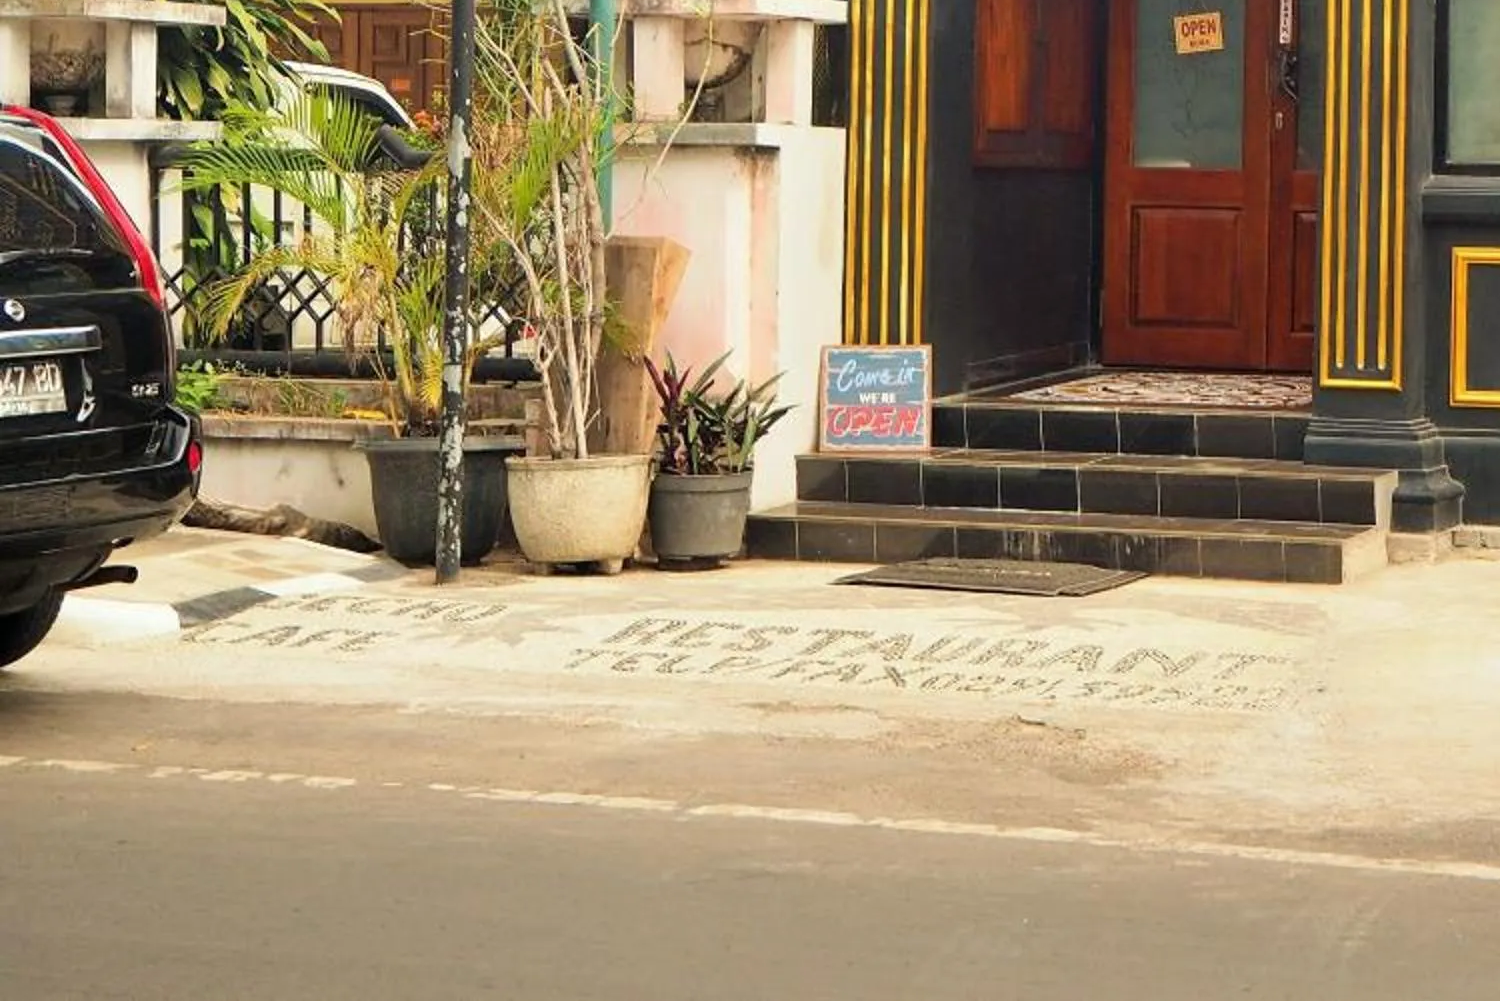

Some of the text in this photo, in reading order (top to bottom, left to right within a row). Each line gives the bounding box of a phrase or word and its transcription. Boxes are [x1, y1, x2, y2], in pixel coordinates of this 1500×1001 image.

[1181, 18, 1217, 38] OPEN
[836, 359, 892, 392] Come
[829, 406, 920, 437] OPEN
[180, 622, 398, 652] CAFE
[603, 617, 1290, 680] RESTAURANT
